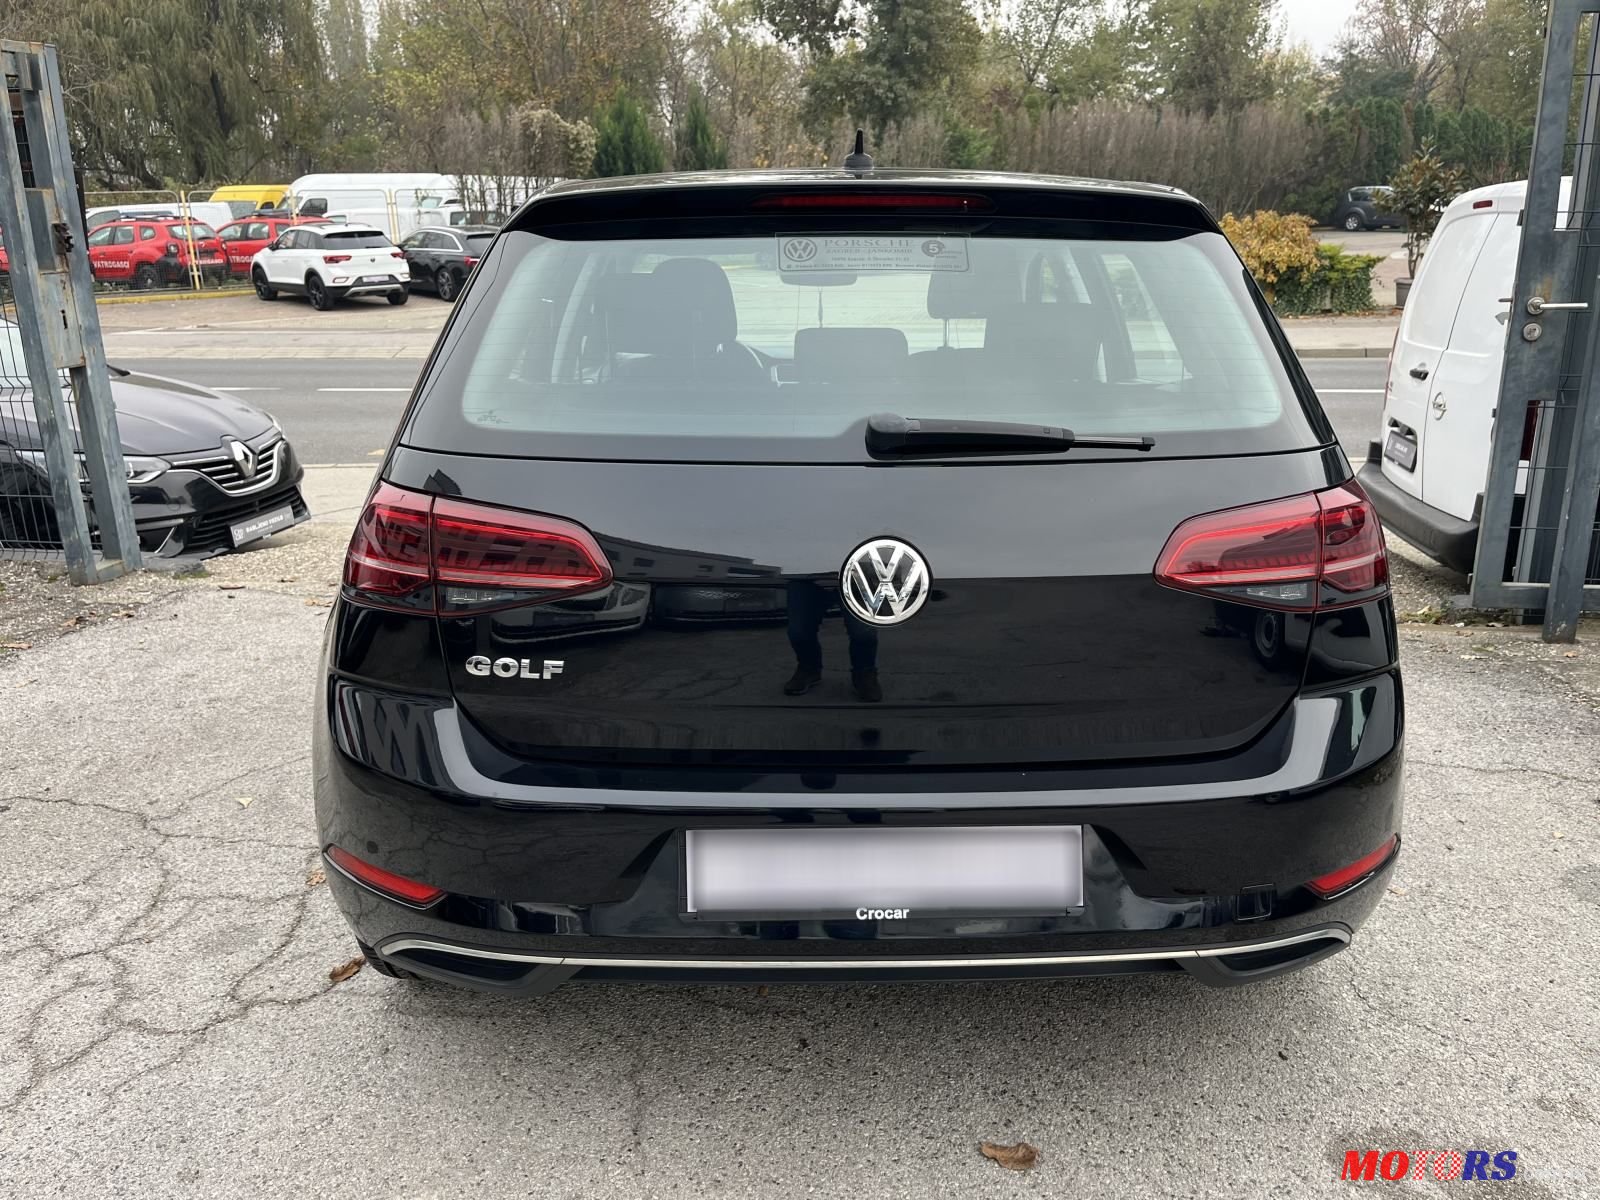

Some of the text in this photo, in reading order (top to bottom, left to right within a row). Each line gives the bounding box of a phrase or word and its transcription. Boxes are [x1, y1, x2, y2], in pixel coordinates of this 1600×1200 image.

[824, 239, 914, 247] PORSCHE
[929, 242, 939, 252] 5
[465, 655, 565, 680] GOLF
[855, 906, 910, 920] Crocar
